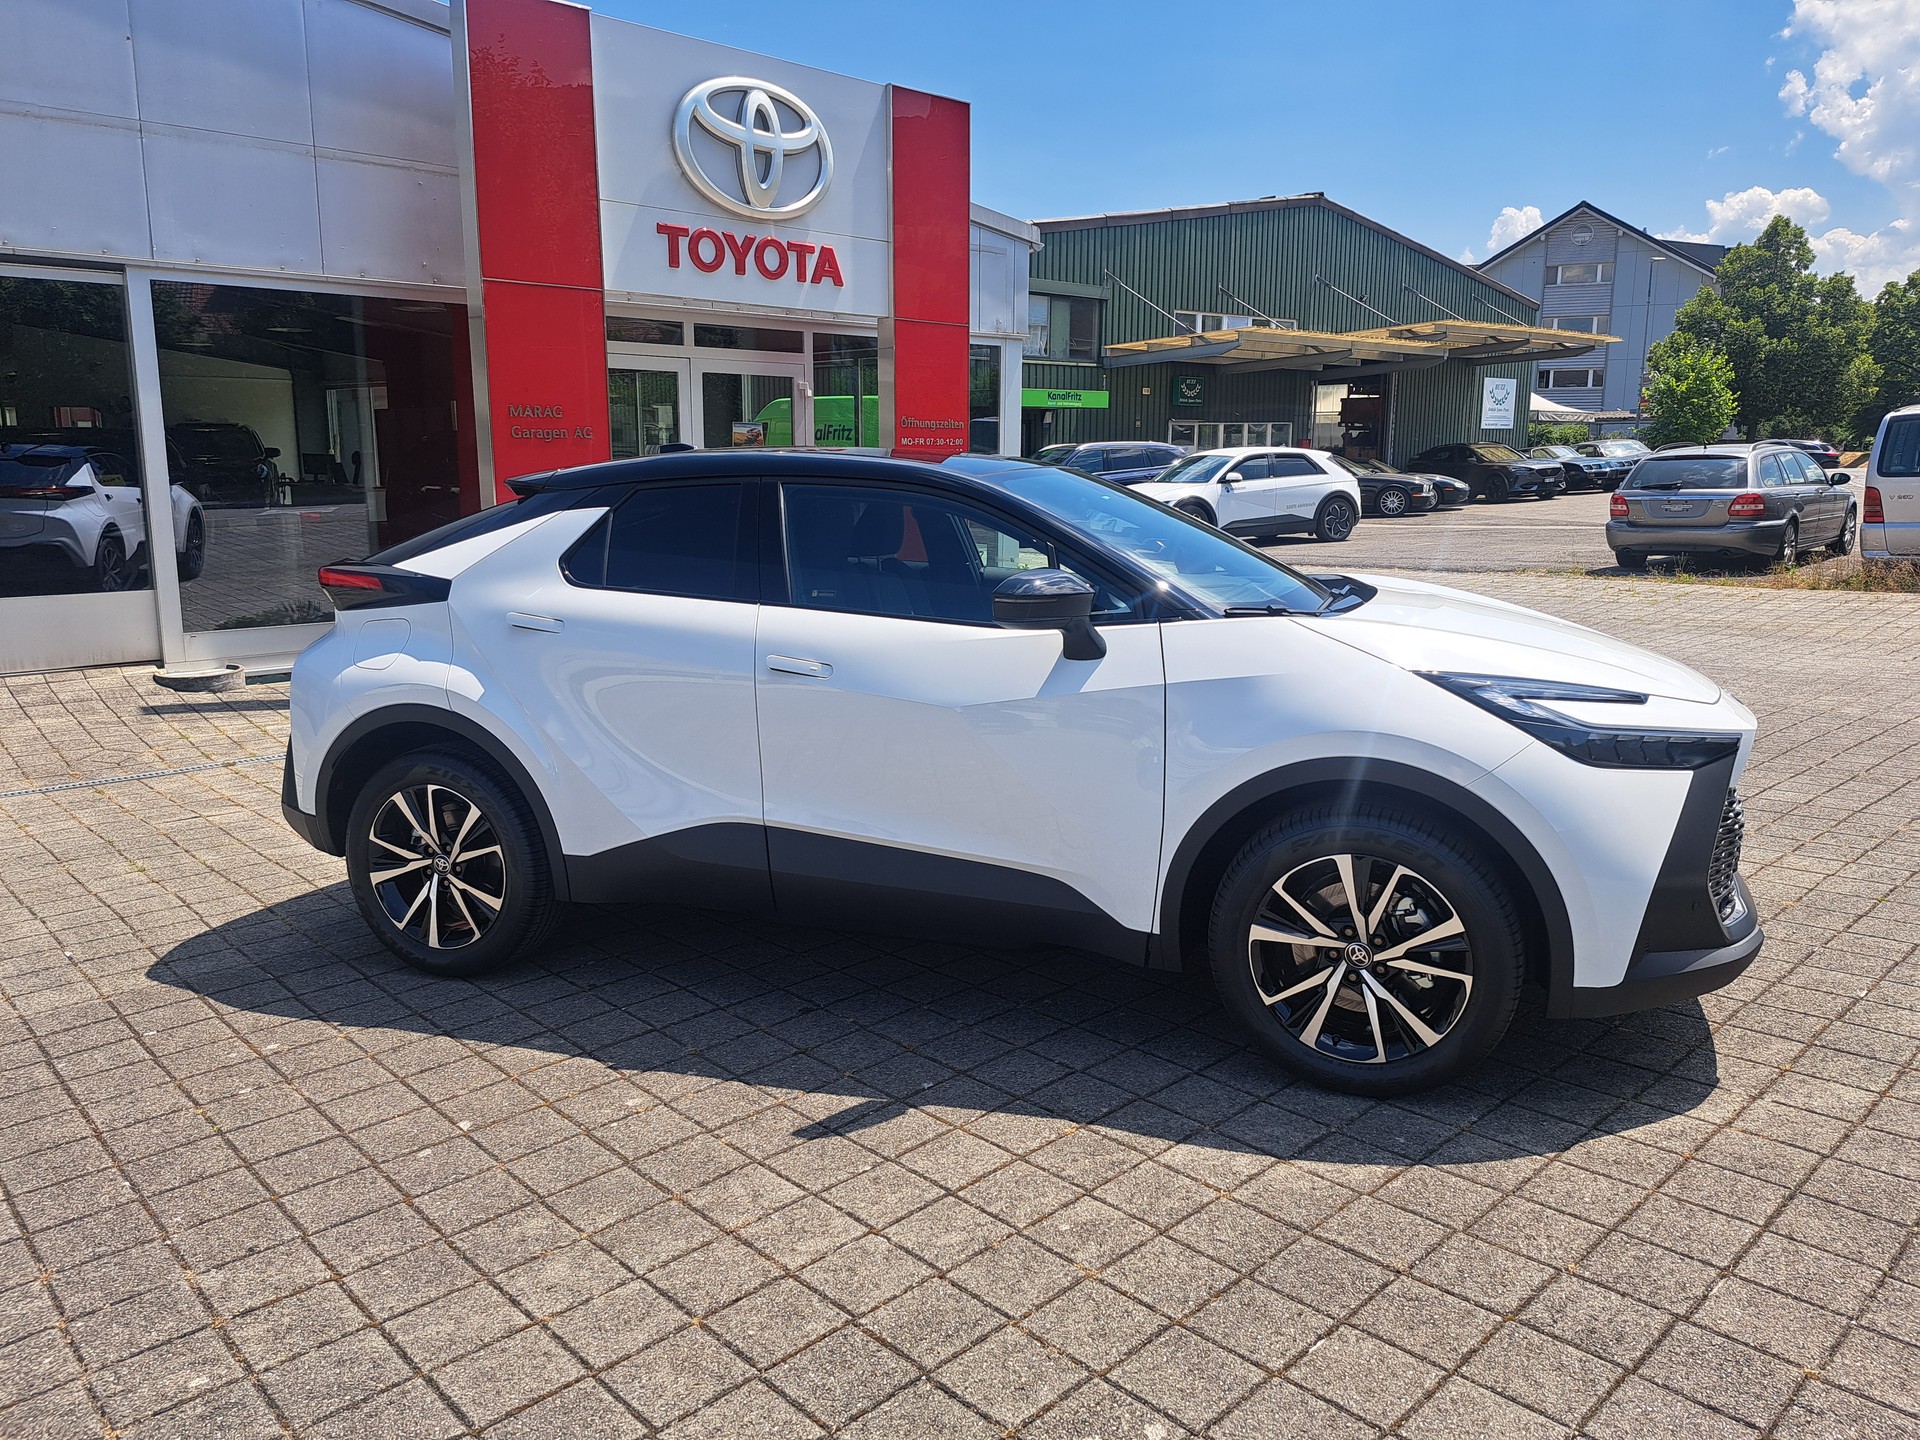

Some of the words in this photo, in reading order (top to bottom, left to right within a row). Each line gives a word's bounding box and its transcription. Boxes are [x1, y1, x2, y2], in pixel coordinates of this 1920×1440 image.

[656, 222, 844, 287] TOYOTA
[1047, 391, 1082, 401] KanalFritz
[508, 404, 564, 418] MARAG
[900, 415, 965, 431] Öffnungszeiten
[511, 425, 569, 442] Garagen
[574, 426, 593, 439] AG
[814, 423, 853, 441] alFritz
[901, 437, 925, 446] MO-FR
[926, 437, 964, 446] 07:30-12:00
